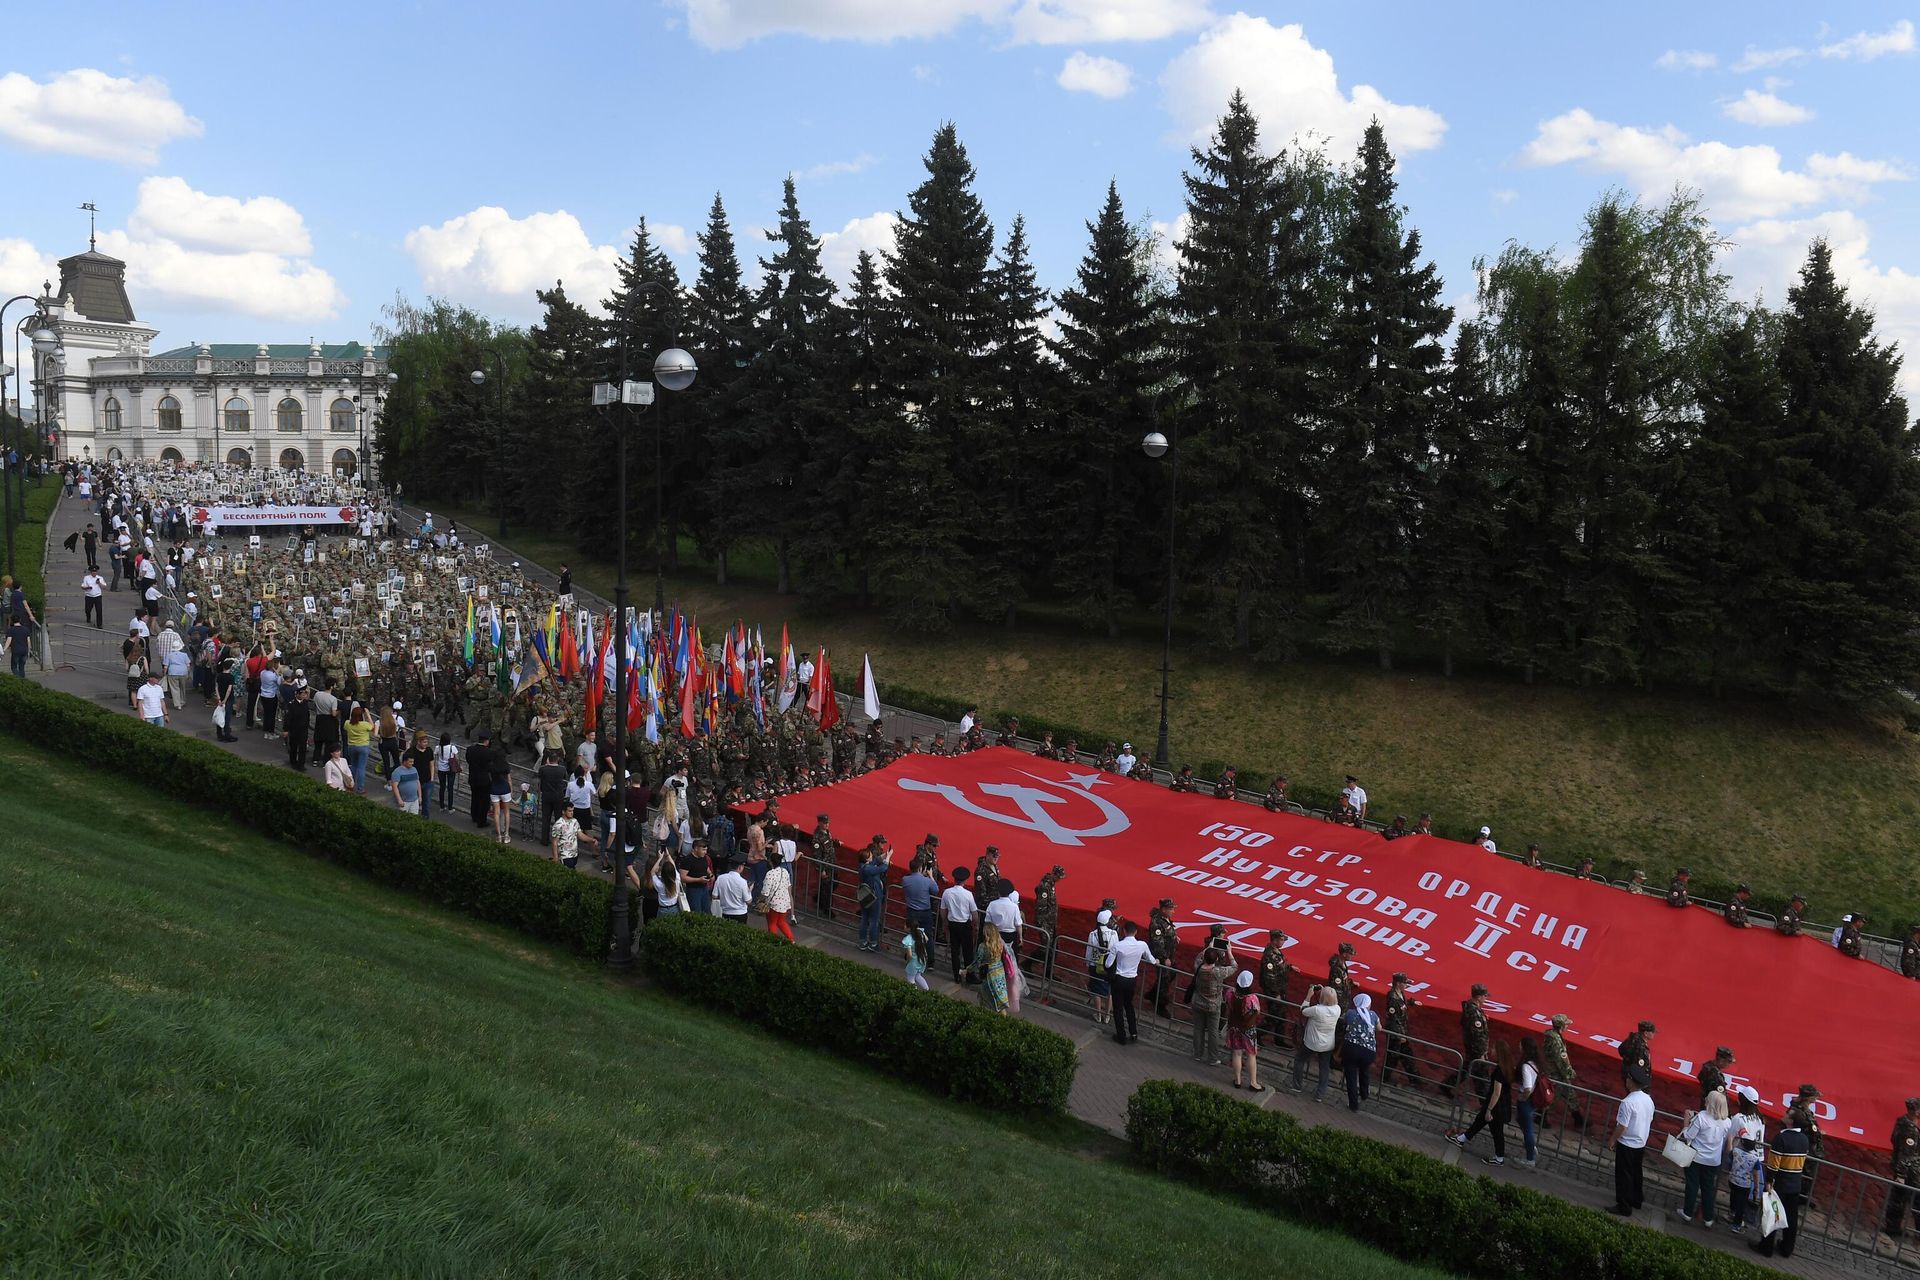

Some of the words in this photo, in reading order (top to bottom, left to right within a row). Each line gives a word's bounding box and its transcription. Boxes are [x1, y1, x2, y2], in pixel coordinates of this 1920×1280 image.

[222, 512, 297, 521] БЕССМЕРТНЫЙ
[300, 512, 327, 520] ПОЛК
[1148, 861, 1325, 921] ИДРИЦК.
[1337, 917, 1437, 964] ДИВ.
[1198, 822, 1275, 848] 150
[1287, 845, 1373, 874] СТР.
[1417, 871, 1589, 951] ОРДЕНА
[1198, 847, 1438, 930] КУТУЗОВА
[1506, 950, 1578, 990] СТ.
